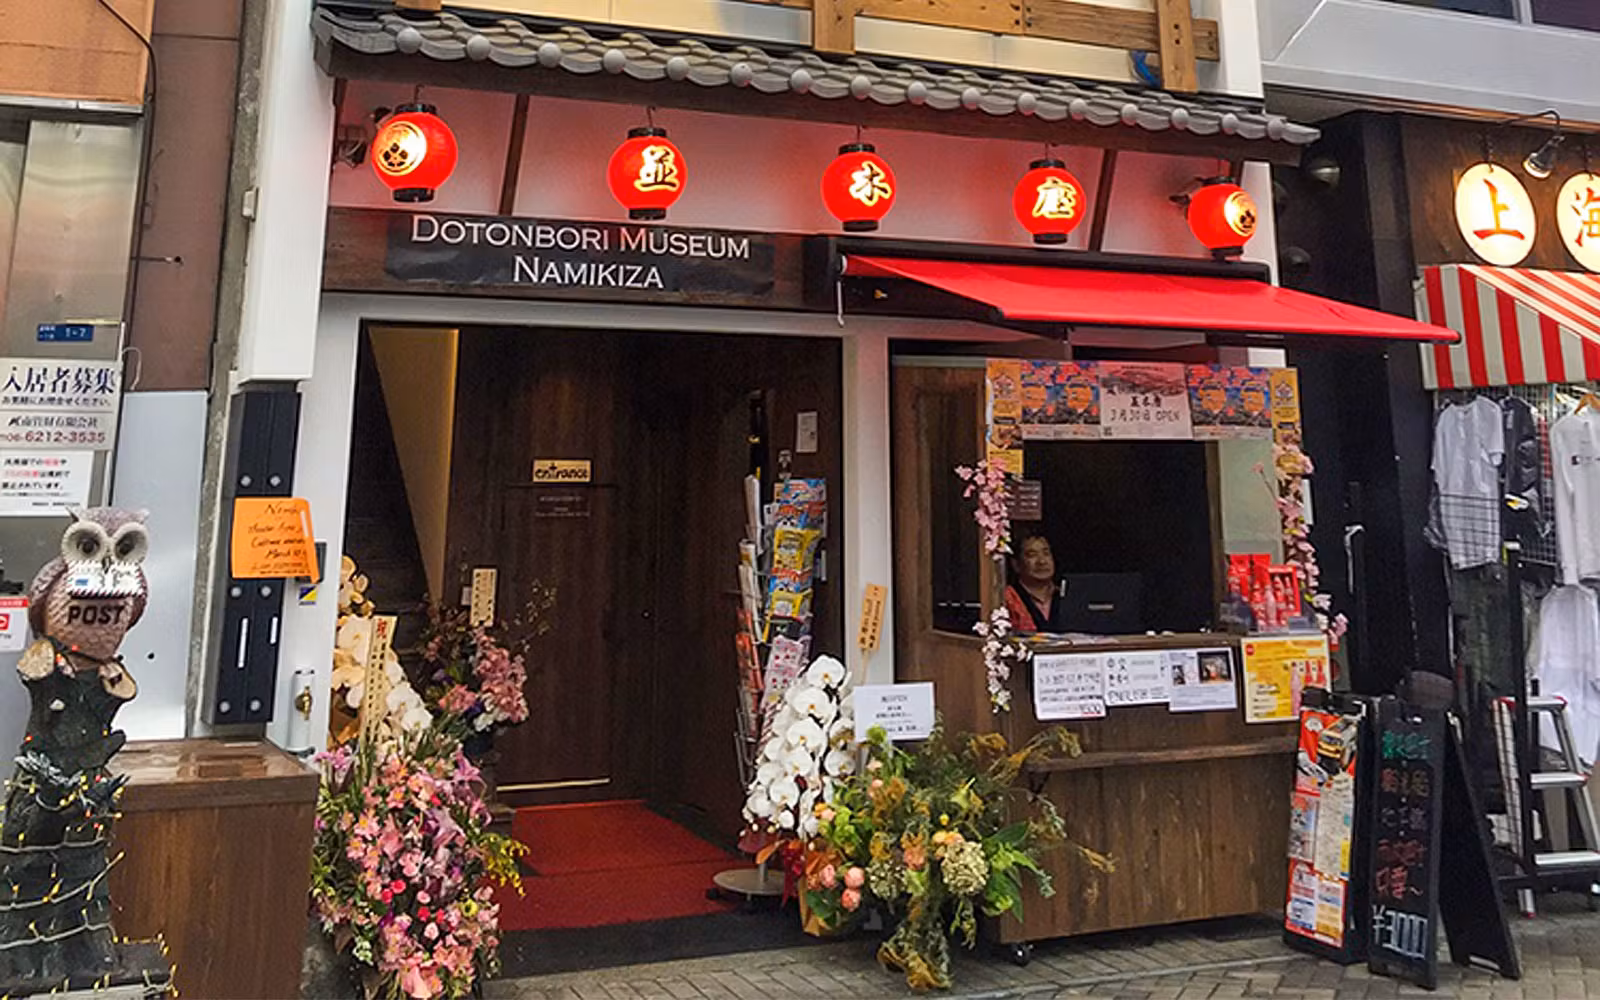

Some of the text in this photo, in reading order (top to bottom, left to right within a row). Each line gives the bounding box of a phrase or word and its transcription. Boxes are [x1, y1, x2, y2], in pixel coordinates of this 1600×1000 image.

[637, 147, 679, 190] 並
[852, 162, 891, 204] 木
[1034, 178, 1074, 216] 座
[1473, 178, 1525, 241] 上
[620, 227, 751, 260] MUSEUM
[512, 255, 665, 290] NAMIKIZA
[2, 366, 115, 394] 入居者募集
[66, 605, 126, 625] POST
